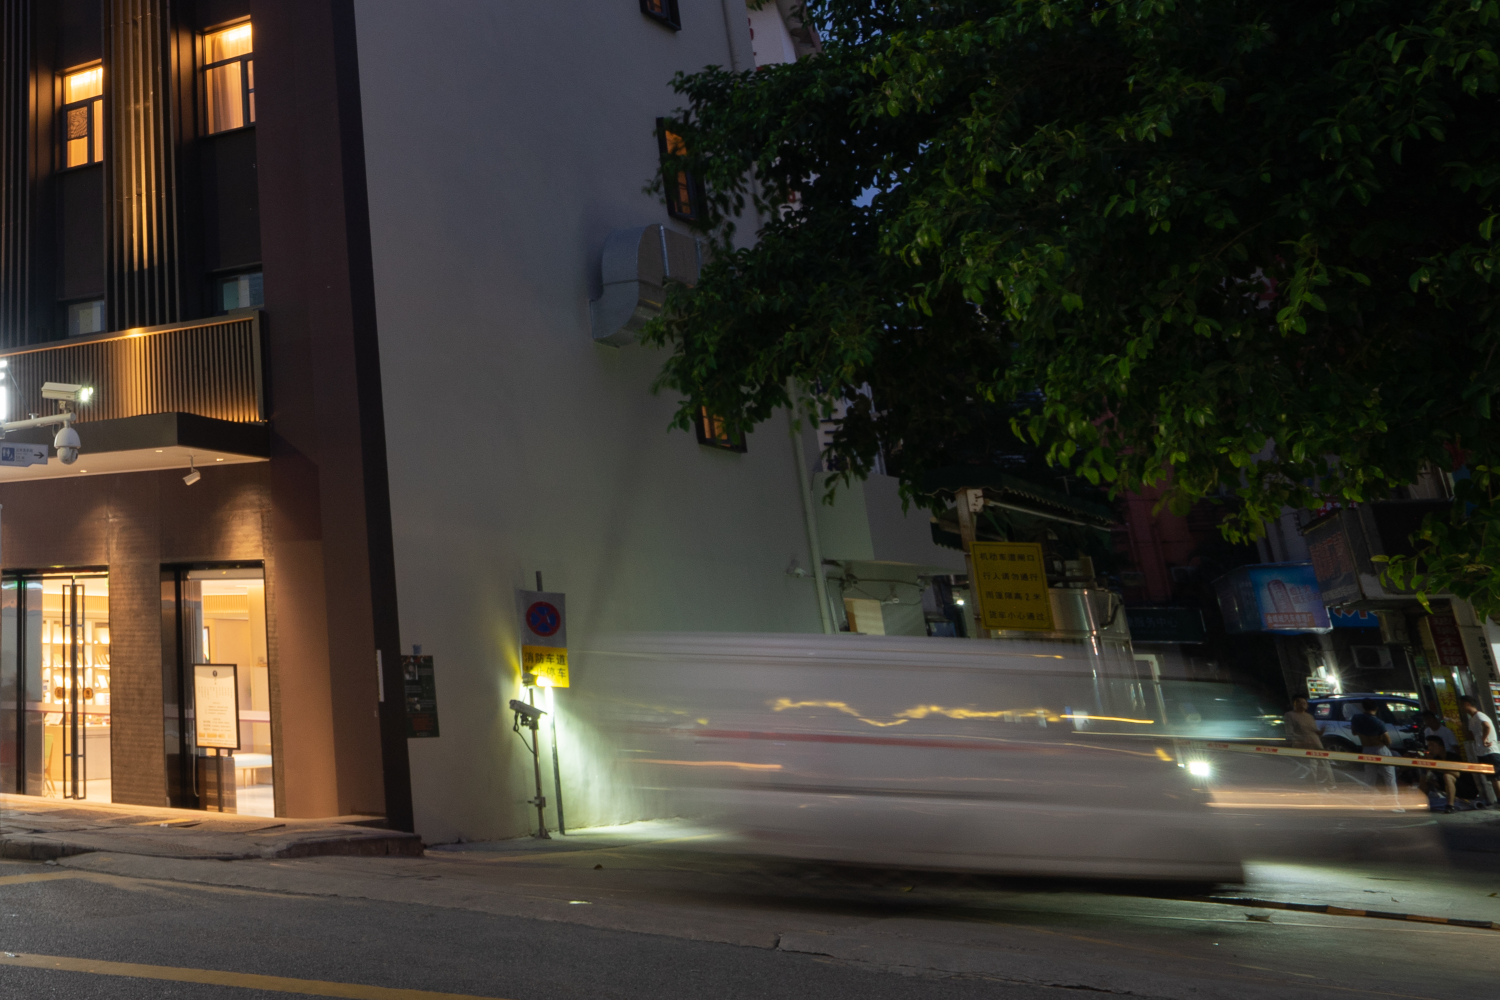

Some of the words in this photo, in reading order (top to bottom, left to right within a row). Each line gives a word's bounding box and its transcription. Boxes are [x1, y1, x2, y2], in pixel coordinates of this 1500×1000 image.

[983, 572, 1038, 582] 行人请勿通行
[525, 652, 566, 665] 消防车道
